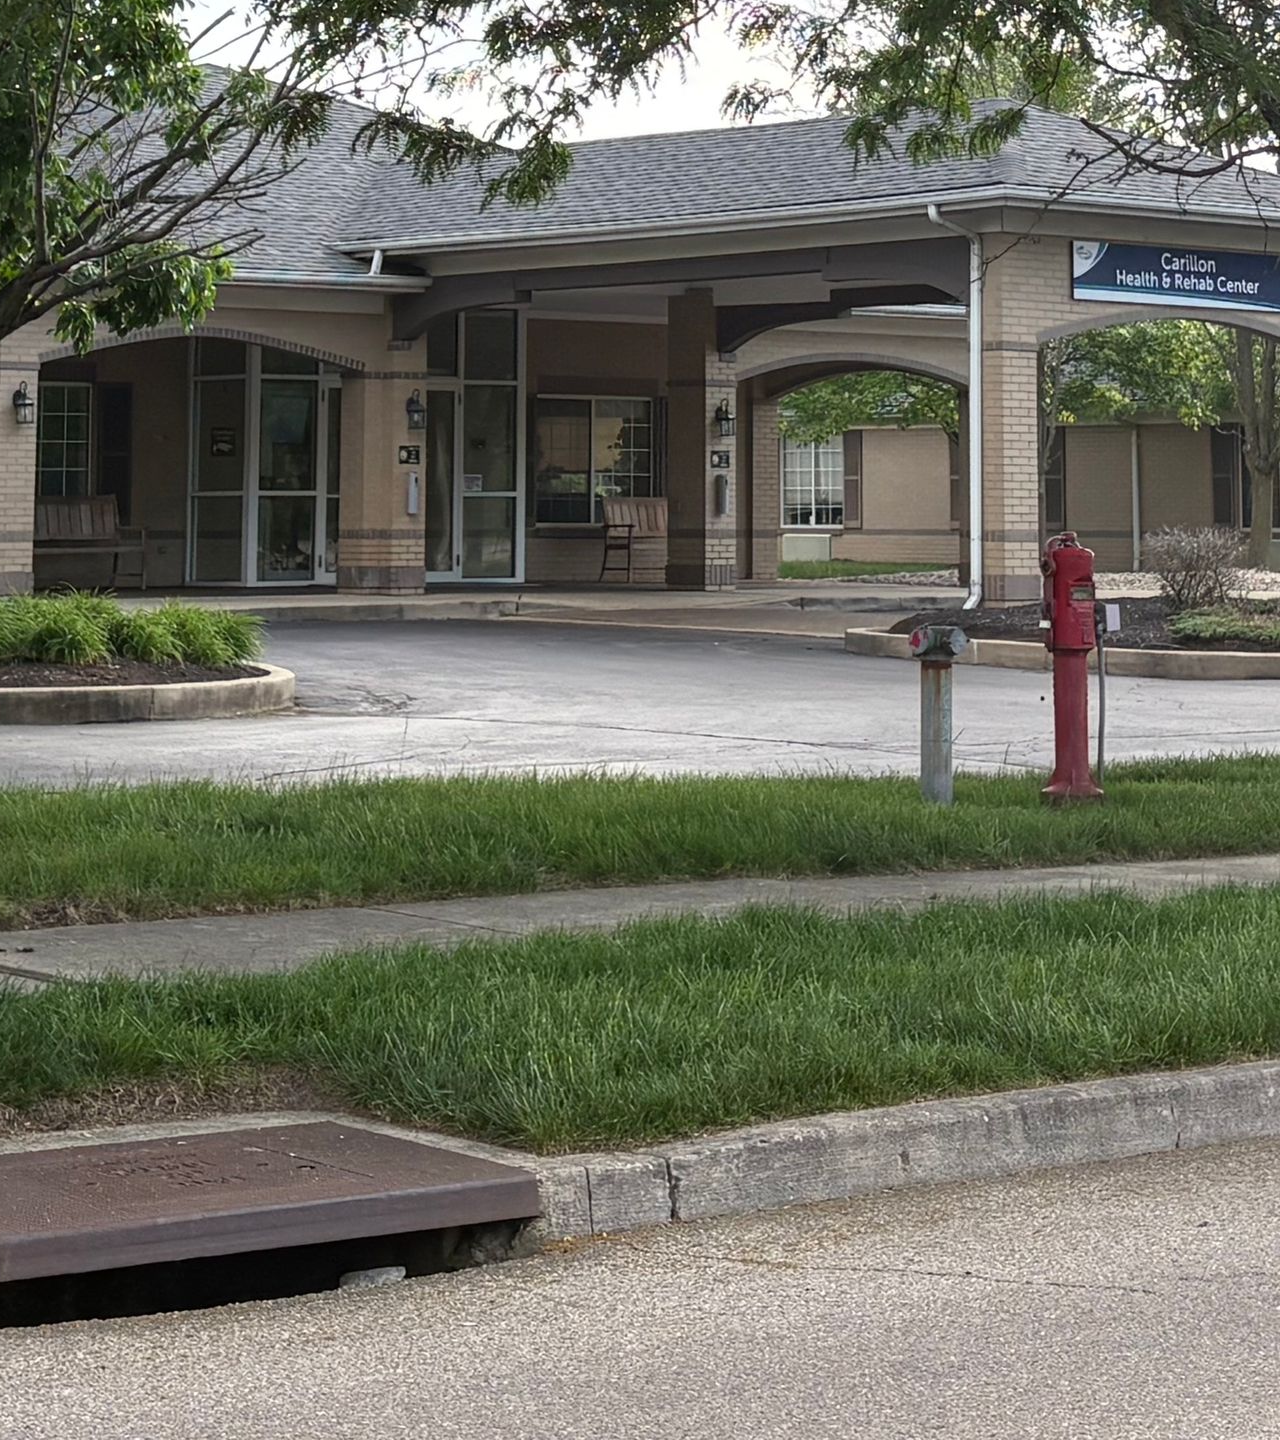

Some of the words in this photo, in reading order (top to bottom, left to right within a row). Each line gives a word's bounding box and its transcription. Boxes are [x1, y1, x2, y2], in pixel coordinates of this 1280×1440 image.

[1161, 252, 1216, 273] Carillon
[1116, 269, 1158, 289] Health
[1162, 273, 1171, 289] &
[1175, 273, 1213, 292] Rehab
[1217, 277, 1259, 295] Center
